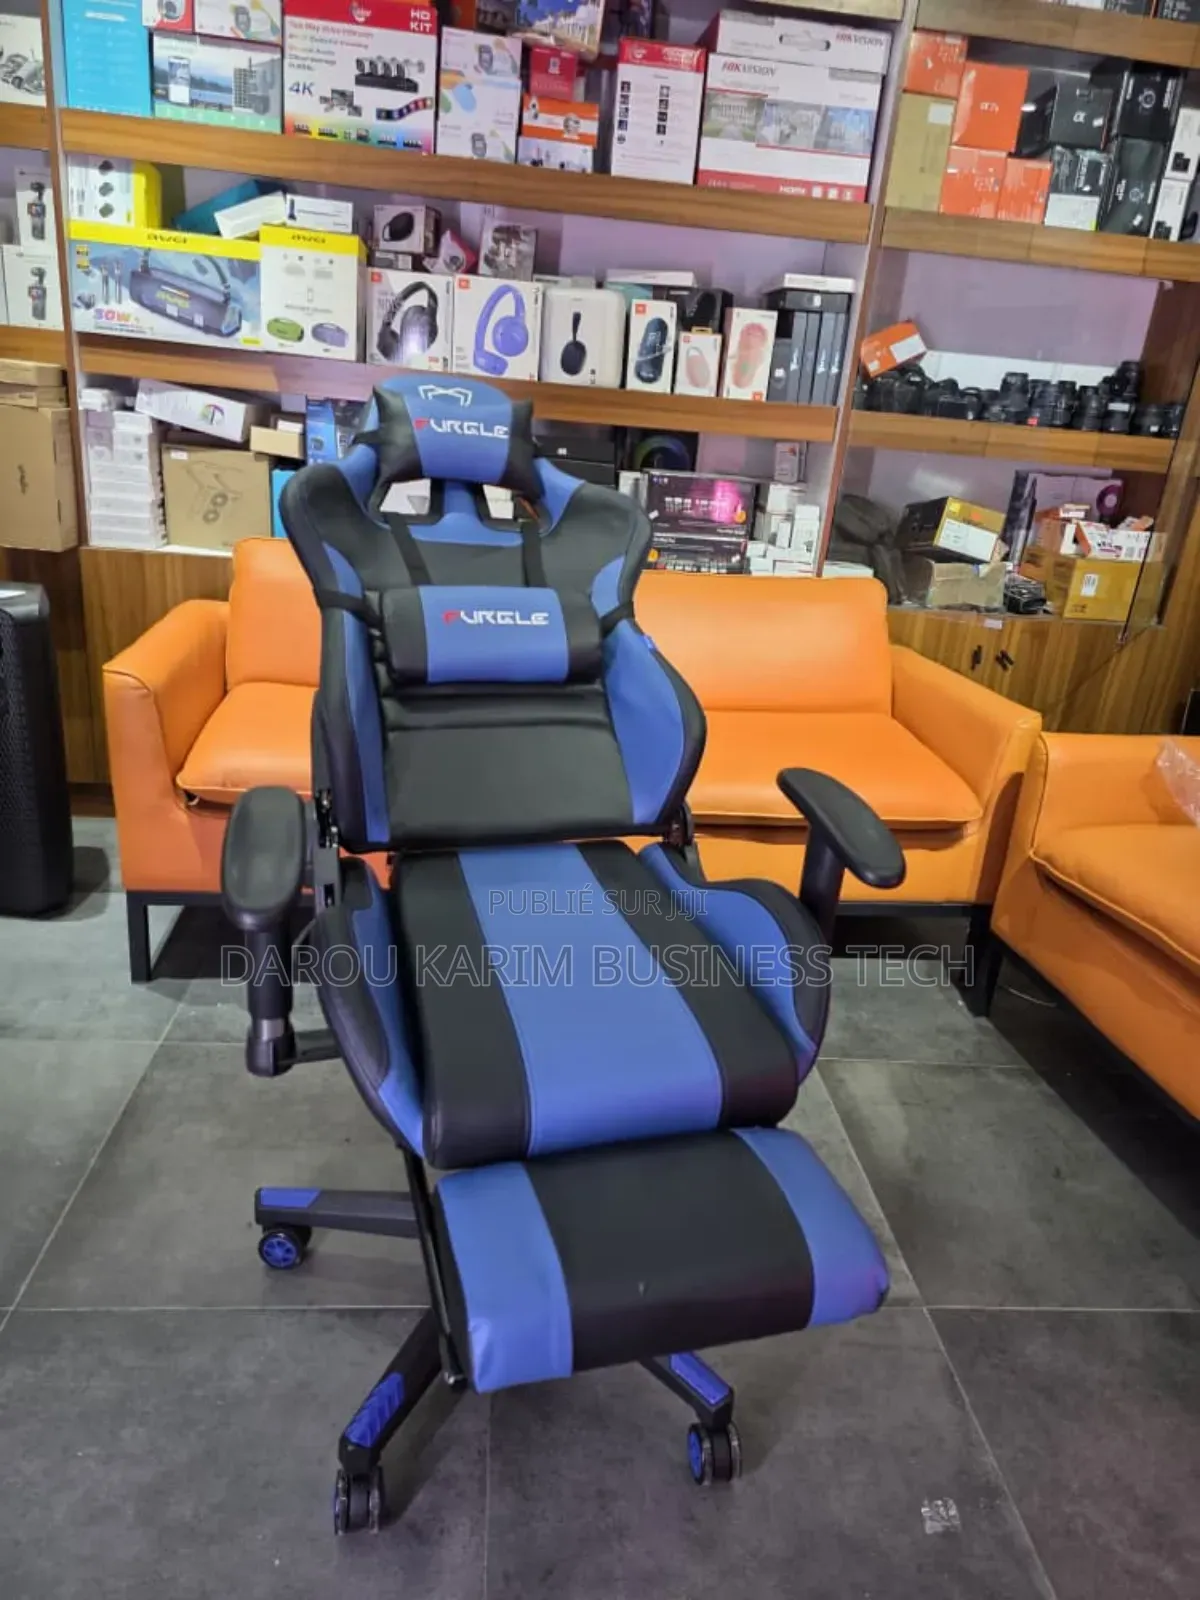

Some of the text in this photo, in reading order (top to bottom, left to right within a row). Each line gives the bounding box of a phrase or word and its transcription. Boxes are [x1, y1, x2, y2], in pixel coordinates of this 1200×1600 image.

[410, 9, 430, 19] HD
[410, 21, 432, 32] KIT
[722, 60, 776, 77] HIKVISION
[289, 80, 314, 95] 4K
[414, 417, 509, 438] FURGLE
[442, 610, 549, 625] FURGLE
